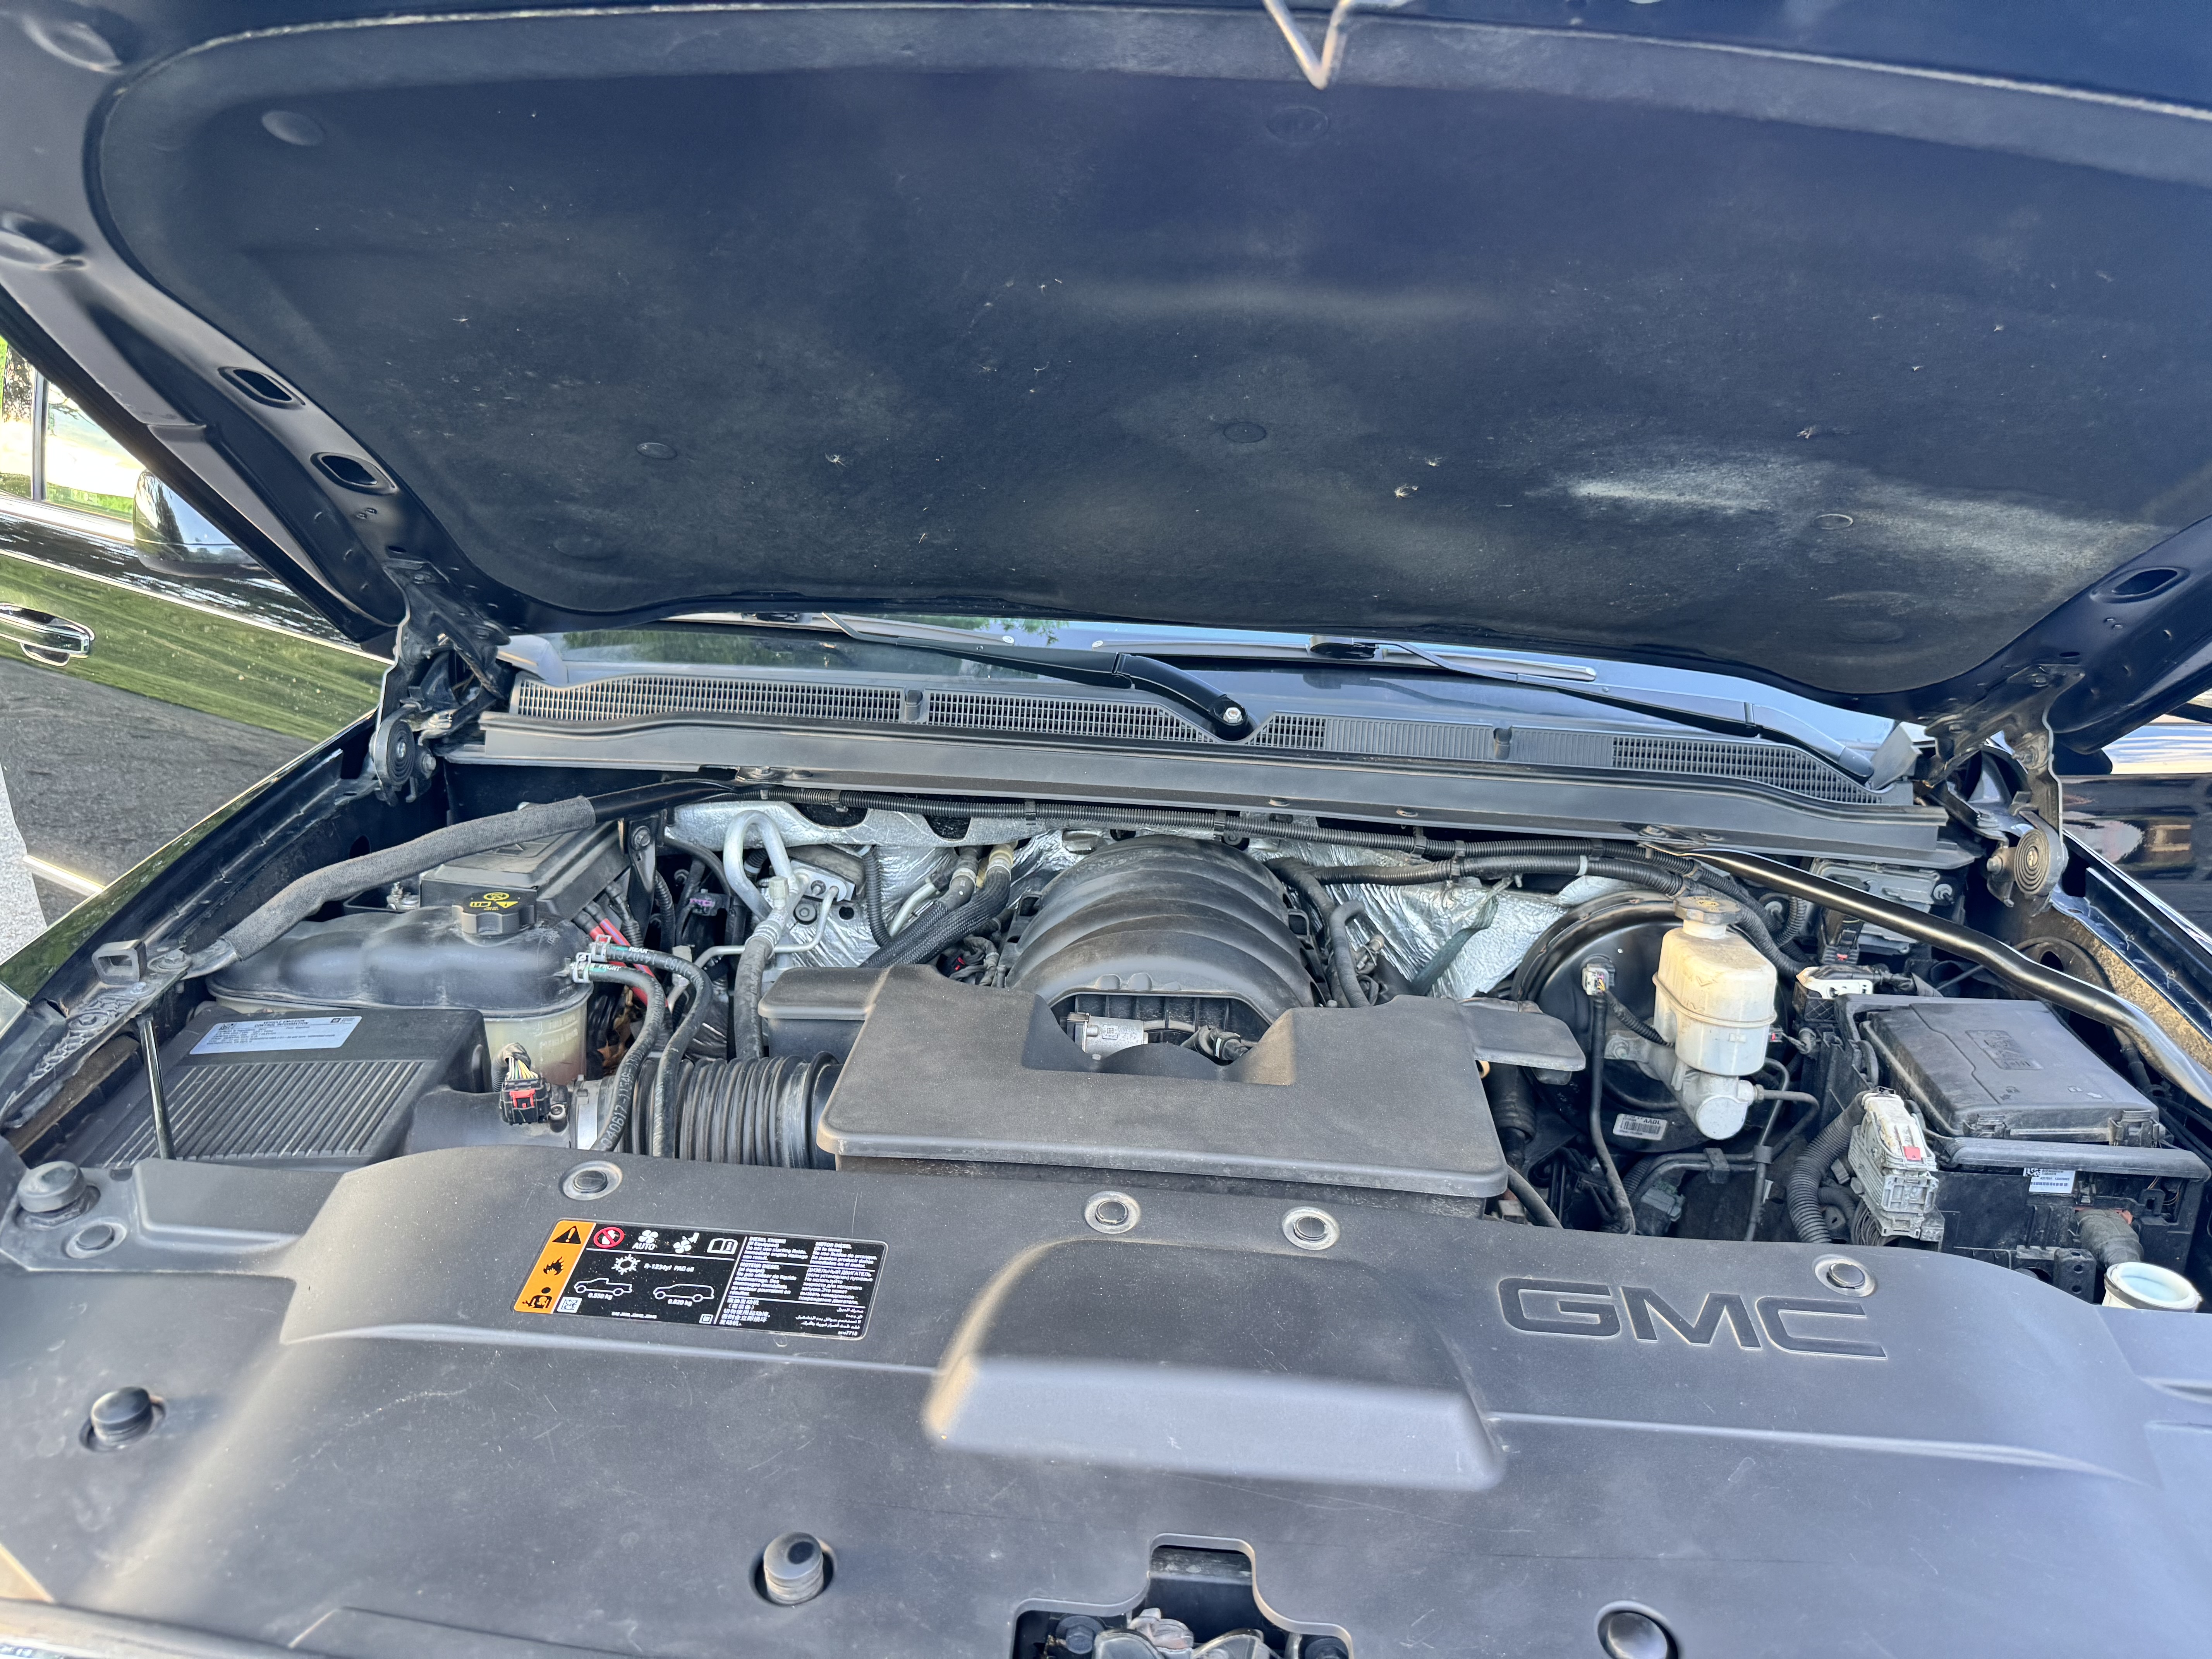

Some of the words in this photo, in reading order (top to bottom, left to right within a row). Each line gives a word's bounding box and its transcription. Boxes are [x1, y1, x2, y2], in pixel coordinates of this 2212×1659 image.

[629, 946, 648, 954] REAR
[632, 1242, 656, 1250] AUTO
[644, 1263, 672, 1271] R-1234yf
[1498, 1276, 1888, 1360] GMC
